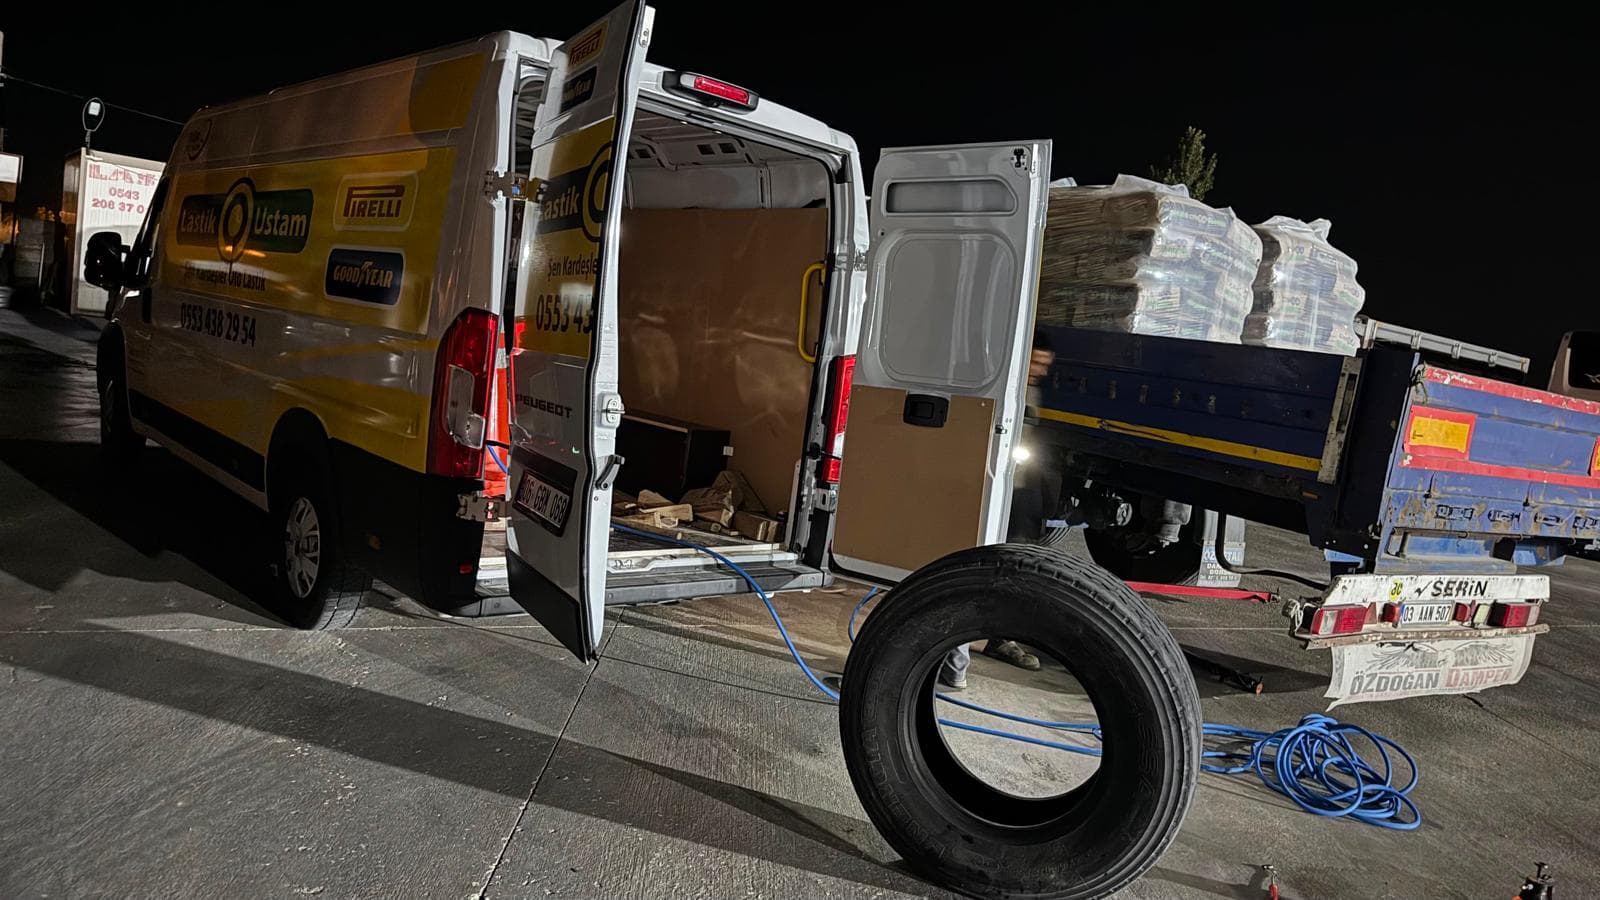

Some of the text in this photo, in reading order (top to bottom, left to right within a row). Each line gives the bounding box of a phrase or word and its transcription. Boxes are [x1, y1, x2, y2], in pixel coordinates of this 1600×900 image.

[92, 197, 115, 210] 208
[118, 201, 134, 213] 37
[109, 187, 140, 201] 0543
[343, 184, 405, 219] PIRELLI
[540, 185, 580, 222] astik
[179, 203, 307, 240] Lastik Ustam
[333, 259, 394, 290] GOODYEAR
[547, 256, 598, 282] Şen Kardeşle
[180, 302, 257, 348] 0553 438 29 54
[535, 294, 594, 334] 0553 43
[515, 393, 573, 419] PEUGEOT
[550, 493, 568, 523] 068
[1403, 606, 1452, 622] 03 AAN 507
[1349, 670, 1440, 696] ÖZDOĞAN
